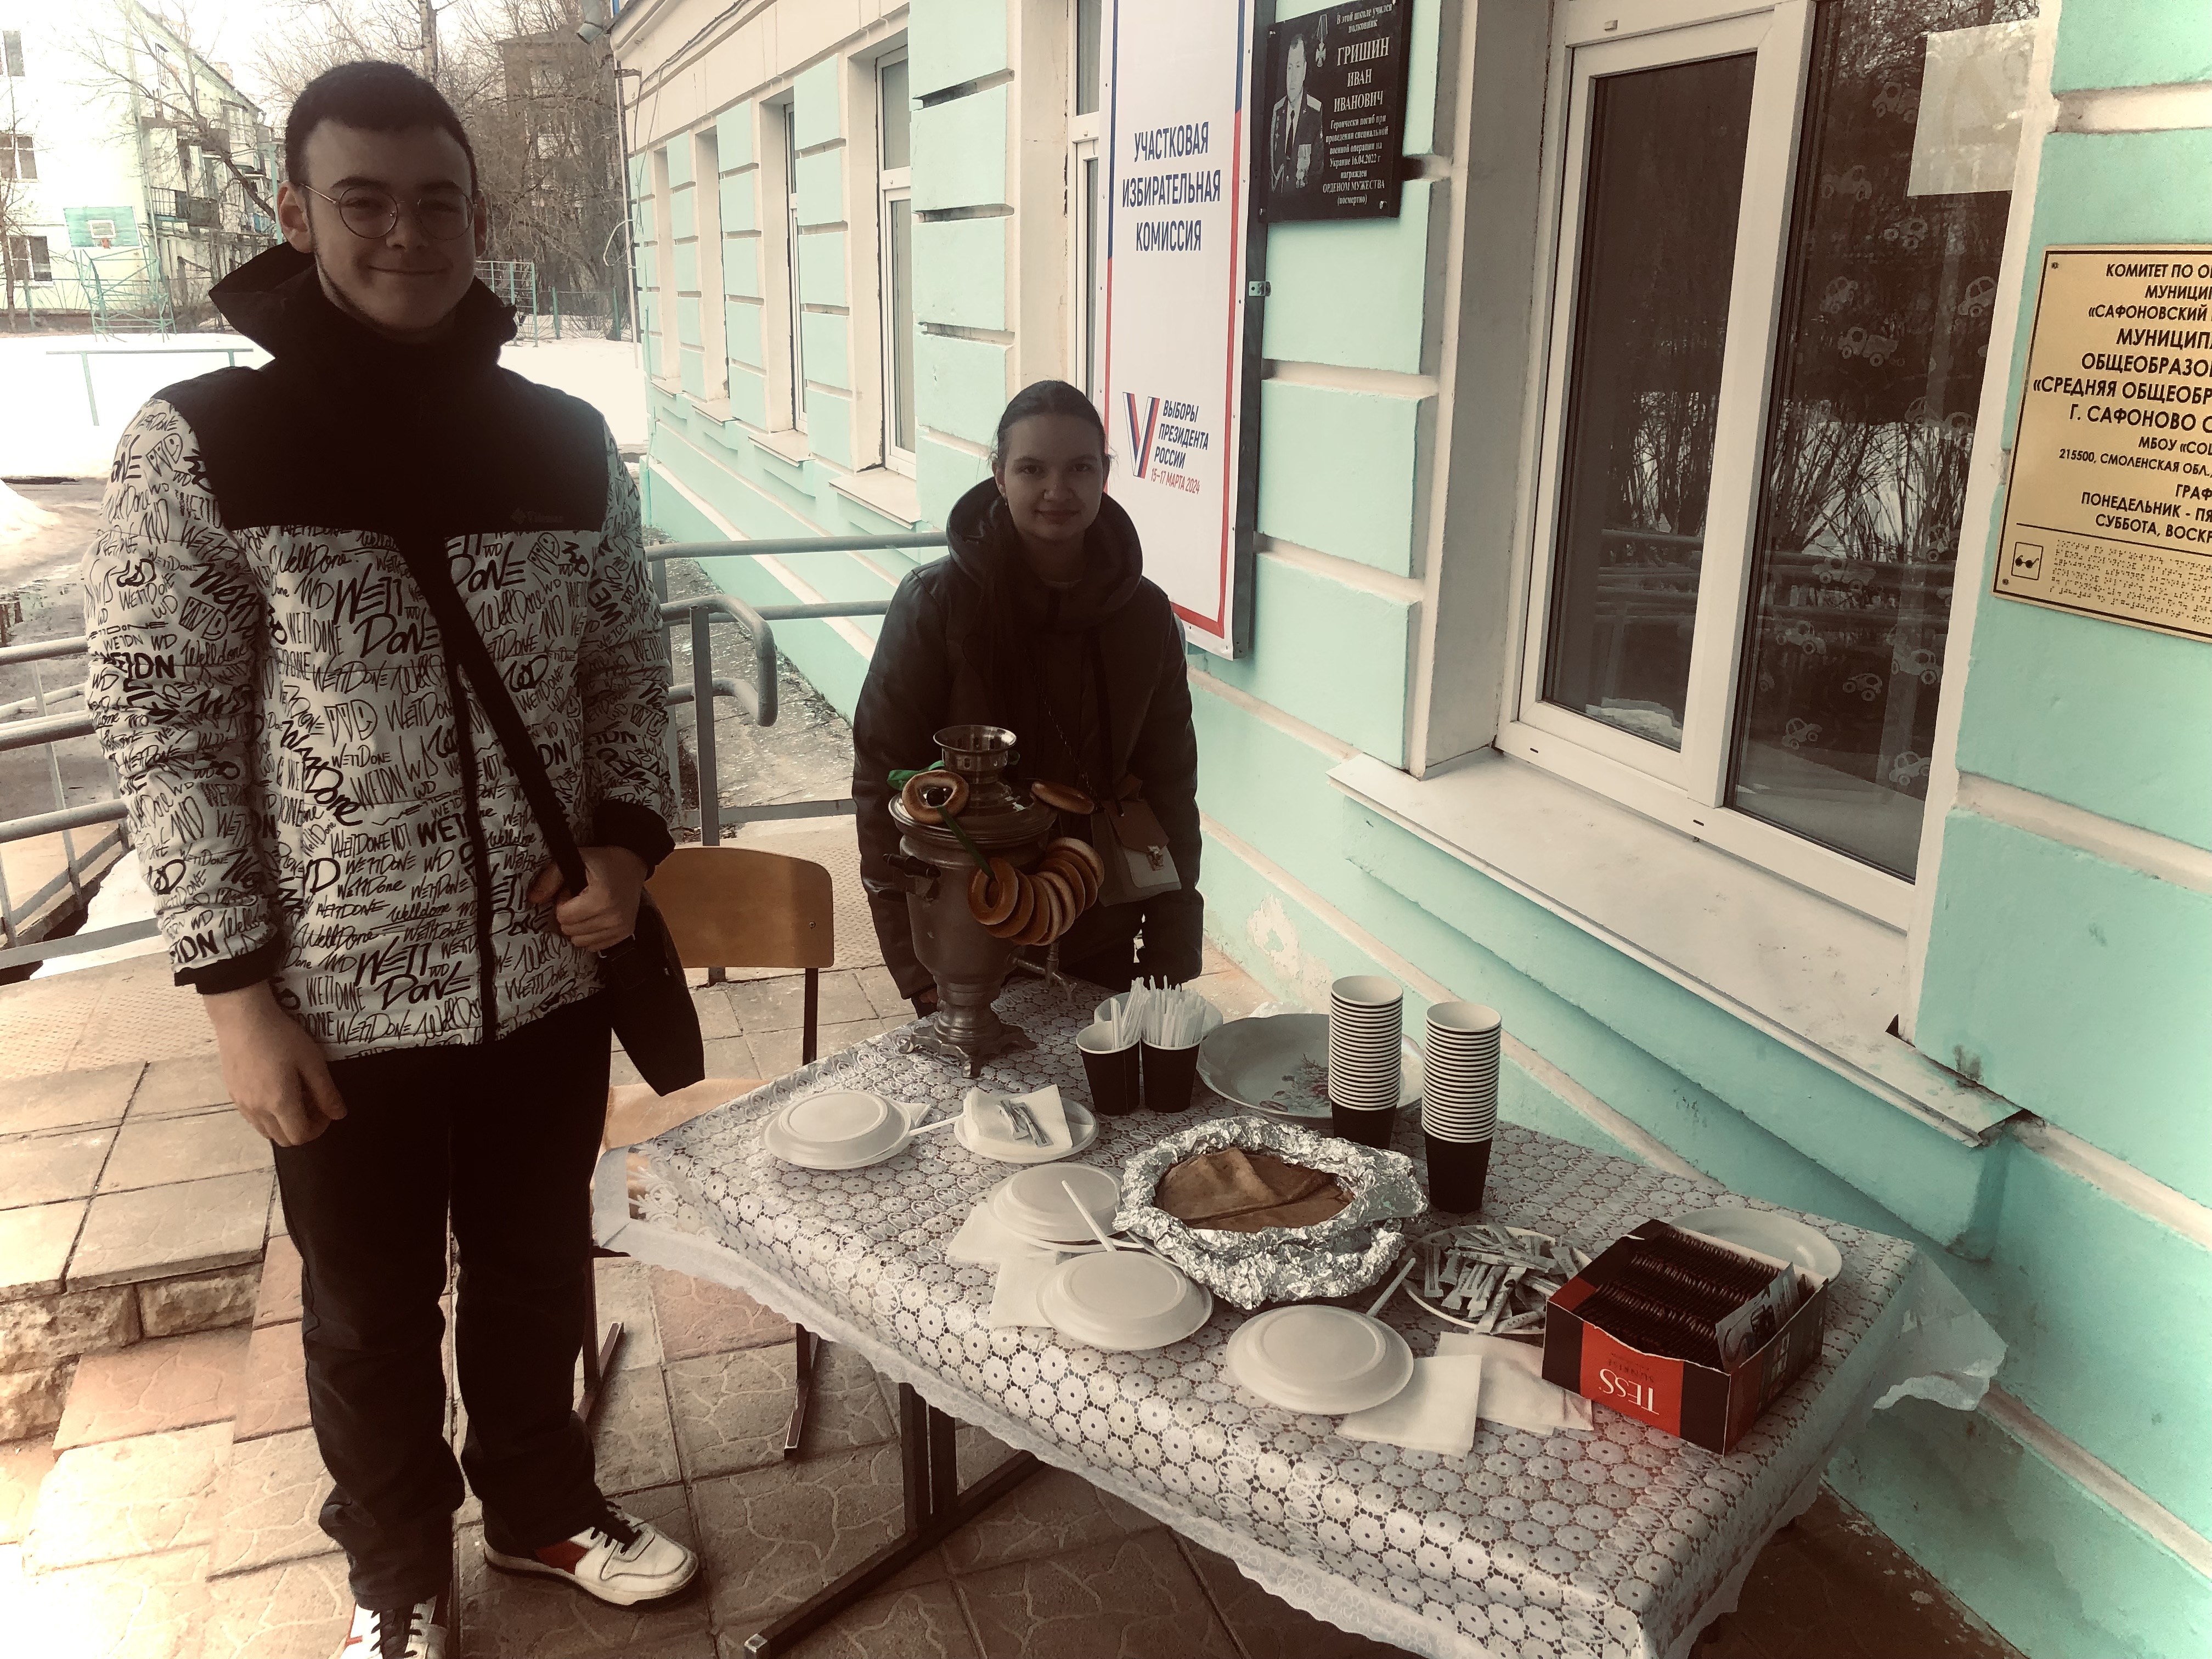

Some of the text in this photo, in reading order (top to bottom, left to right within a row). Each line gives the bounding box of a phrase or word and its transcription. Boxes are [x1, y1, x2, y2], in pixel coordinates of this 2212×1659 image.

[1336, 14, 1341, 25] В
[1337, 36, 1390, 66] ГРИШИН
[1347, 69, 1372, 87] ИВАН
[1334, 90, 1383, 112] ИВАНОВИЧ
[1330, 114, 1386, 131] Героически погиб при
[1134, 121, 1209, 162] УЧАСТКОВАЯ
[1325, 126, 1389, 144] проведении специальной
[1350, 143, 1375, 154] операции
[1330, 157, 1351, 169] Украине
[1351, 153, 1376, 165] 16.04.2022
[1122, 170, 1221, 208] ИЗБИРАТЕЛЬНАЯ
[1323, 179, 1385, 194] ОРДЕНОМ МУЖЕСТВА
[1338, 194, 1367, 206] (посмертно)
[1136, 219, 1202, 252] КОМИССИЯ
[2106, 263, 2212, 279] КОМИТЕТ ПО О
[2088, 303, 2208, 321] «САФОНОВСКИЙ
[2116, 328, 2212, 351] МУНИЦИП
[2081, 352, 2212, 377] ОБЩЕОБРАЗО
[2033, 375, 2118, 398] «СРЕДНЯЯ
[1163, 399, 1199, 423] ВЫБОРЫ
[2069, 404, 2081, 421] Г.
[2087, 405, 2197, 431] САФОНОВО
[1158, 423, 1209, 450] ПРЕЗИДЕНТА
[2138, 436, 2177, 452] МБОУ
[1154, 446, 1187, 469] РОССИИ
[2059, 448, 2097, 464] 215500,
[2100, 453, 2180, 473] СМОЛЕНСКАЯ
[1166, 473, 1184, 491] МАРТА
[1185, 478, 1200, 494] 2024
[2081, 492, 2181, 518] ПОНЕДЕЛЬНИК
[2095, 514, 2161, 537] СУББОТА,
[1600, 1368, 1660, 1415] TESS
